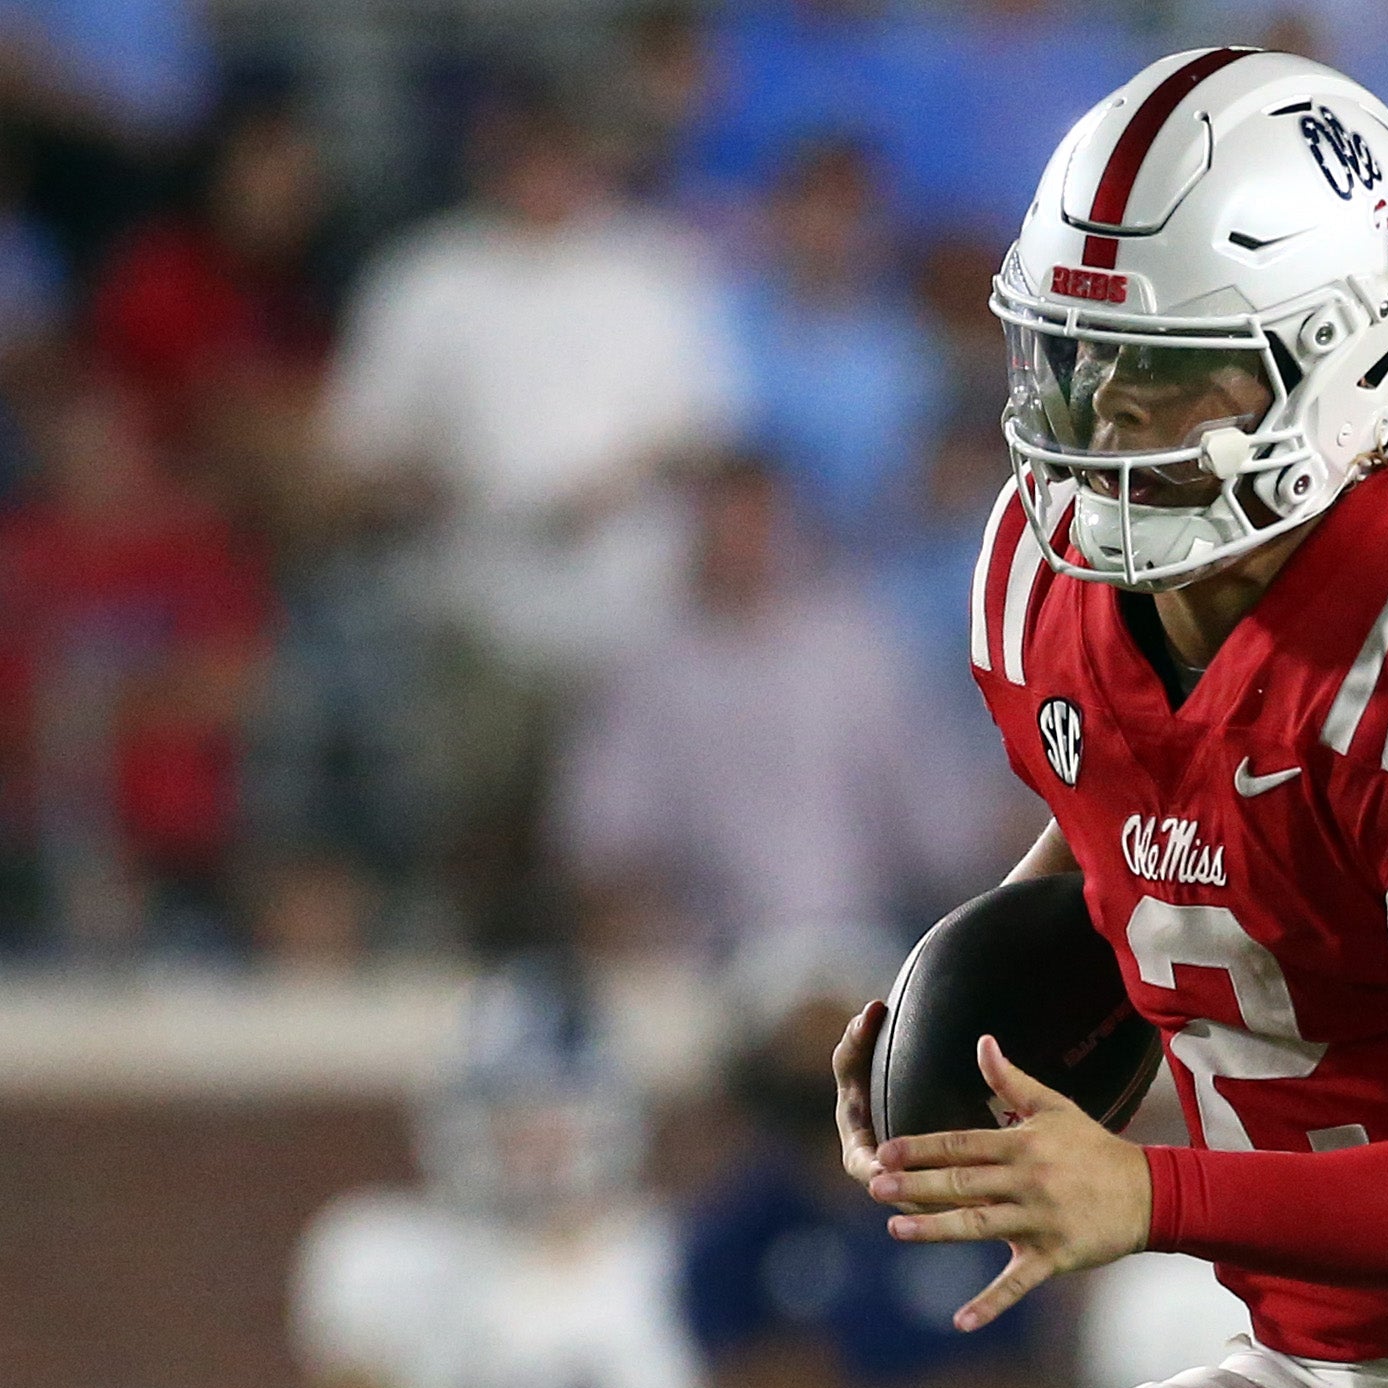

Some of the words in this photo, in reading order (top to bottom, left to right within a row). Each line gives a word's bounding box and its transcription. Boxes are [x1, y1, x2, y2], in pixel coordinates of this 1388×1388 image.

[1051, 266, 1127, 304] REBS
[1040, 700, 1080, 785] SEC
[1122, 814, 1159, 880] Ole
[1160, 818, 1226, 886] Miss
[1127, 896, 1369, 1151] 2
